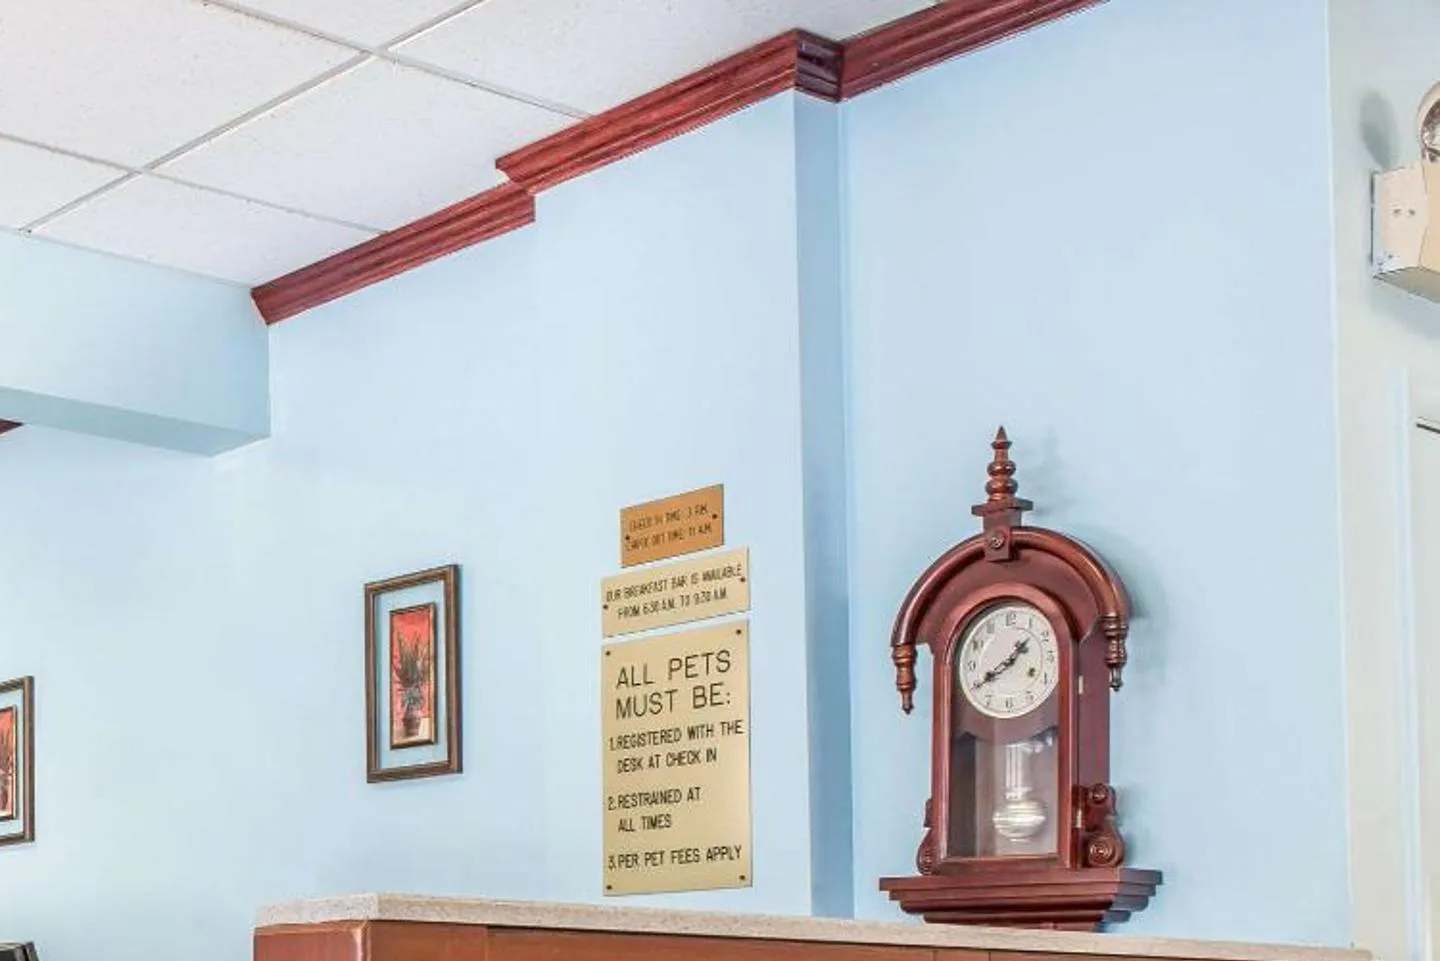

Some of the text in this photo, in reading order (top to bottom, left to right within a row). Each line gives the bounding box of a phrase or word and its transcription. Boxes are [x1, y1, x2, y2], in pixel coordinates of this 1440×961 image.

[606, 564, 742, 602] OUR BREAKFAST BAR IS AVAILABLE
[618, 606, 641, 620] FROM
[680, 595, 690, 606] TO
[616, 649, 731, 689] ALL PETS
[616, 682, 731, 720] MUST BE:
[688, 724, 714, 740] WITH
[720, 720, 744, 736] THE
[617, 748, 717, 774] DESK AT CHECK IN
[687, 787, 701, 802] AT
[618, 814, 672, 832] ALL TIMES
[644, 850, 665, 866] PET
[671, 848, 701, 865] FEES
[706, 845, 742, 862] APPLY
